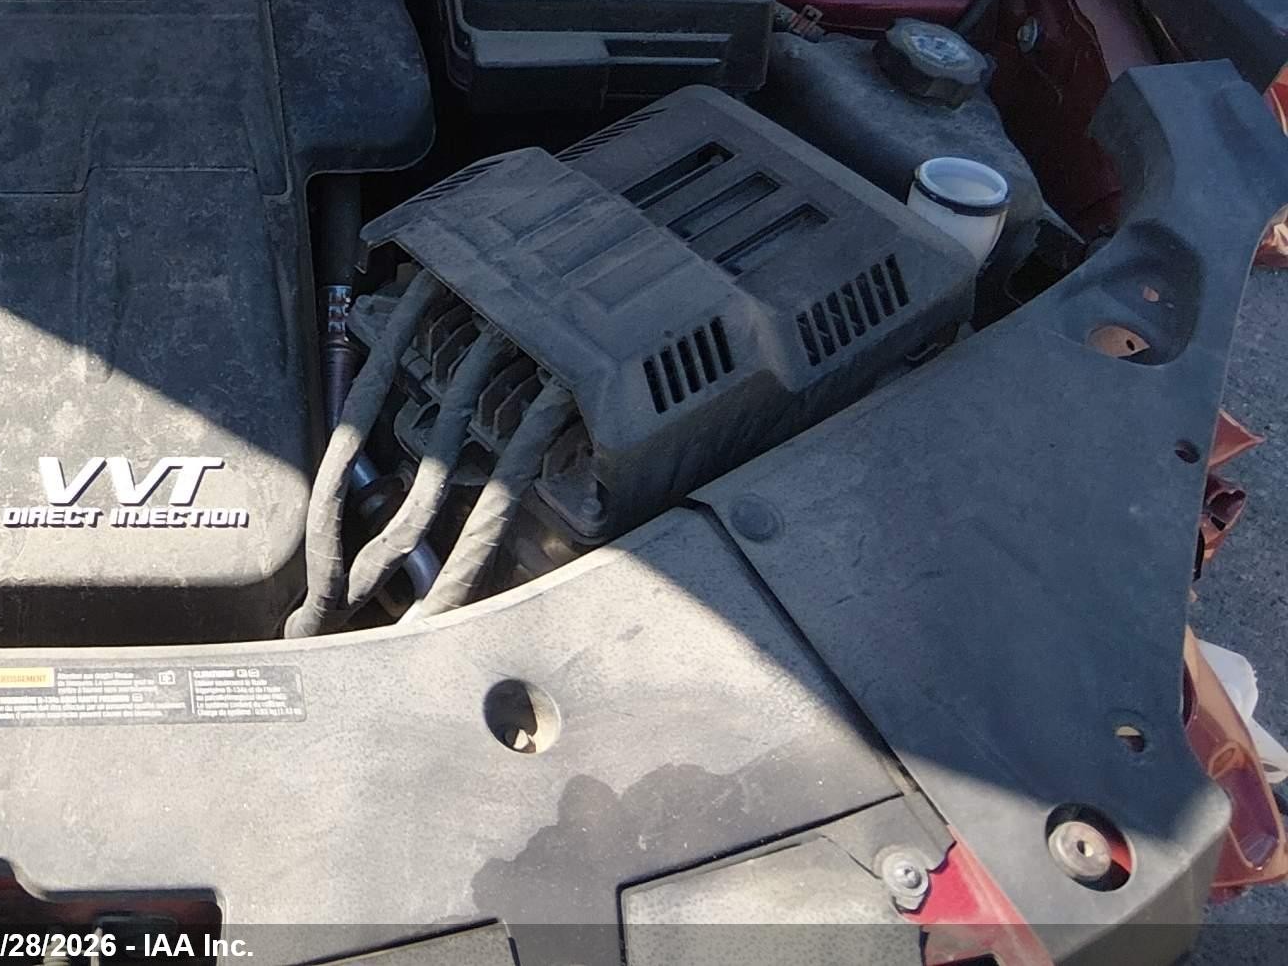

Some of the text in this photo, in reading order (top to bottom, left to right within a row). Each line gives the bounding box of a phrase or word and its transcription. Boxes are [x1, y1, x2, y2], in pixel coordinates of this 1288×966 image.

[38, 456, 225, 506] VVT
[3, 506, 249, 529] DIRECT INJECTION
